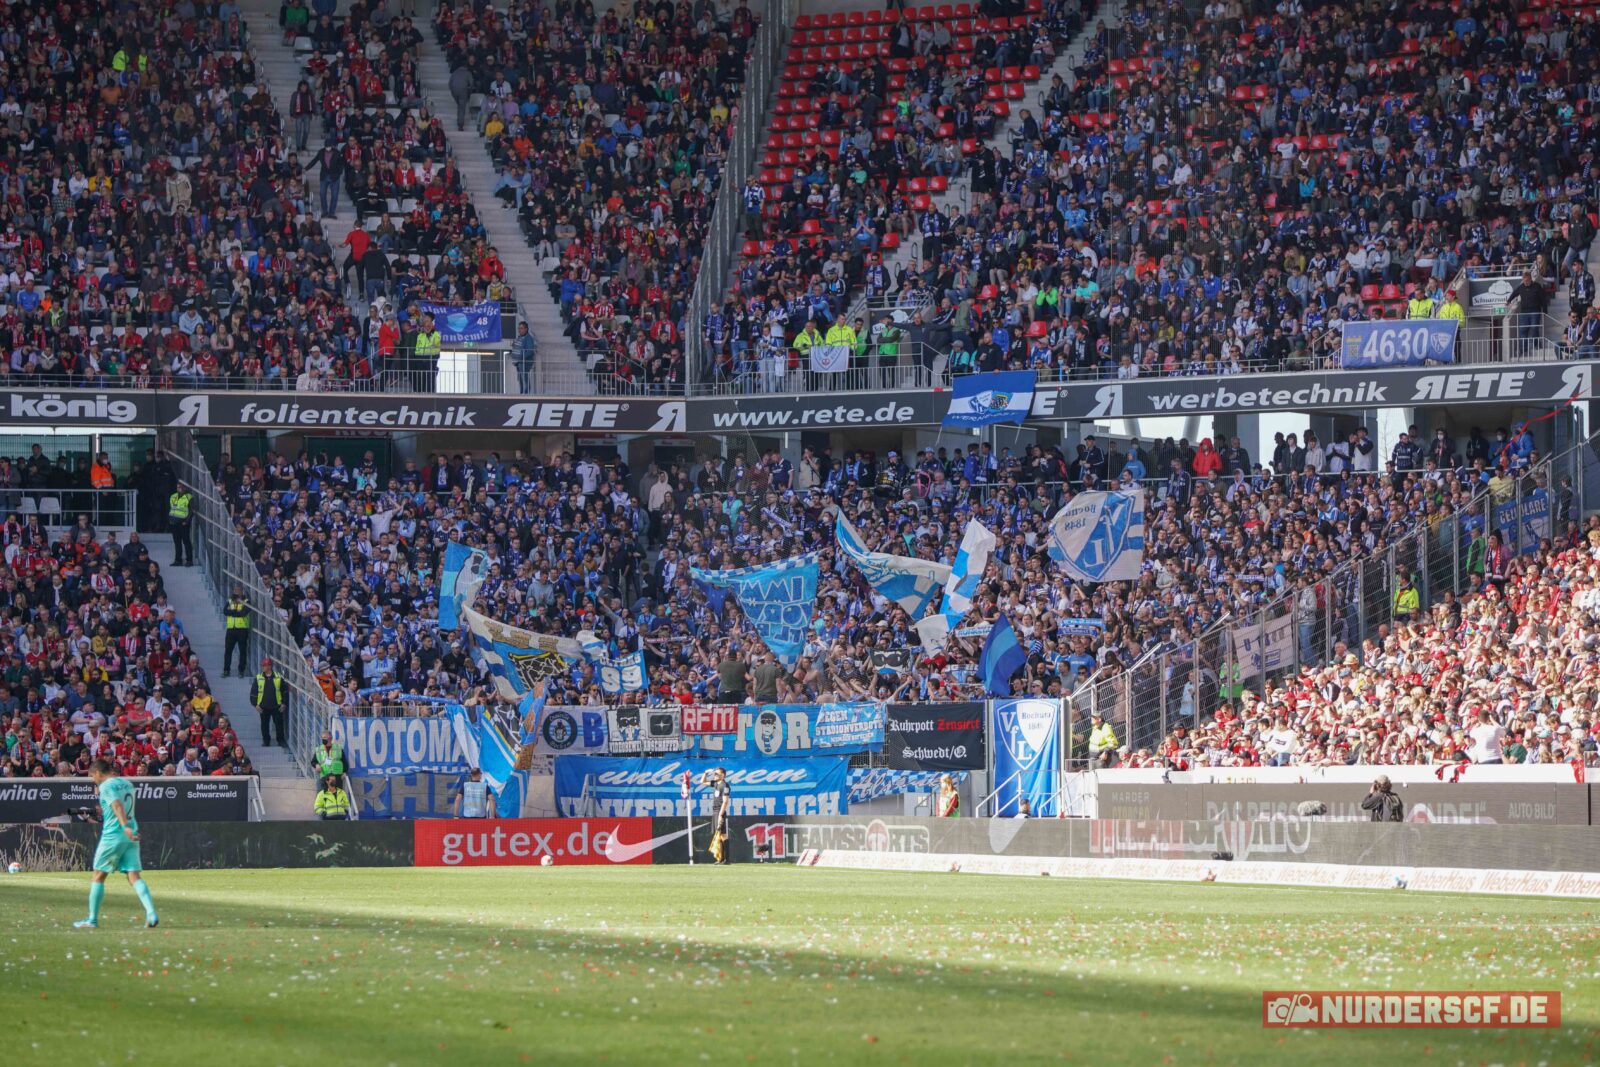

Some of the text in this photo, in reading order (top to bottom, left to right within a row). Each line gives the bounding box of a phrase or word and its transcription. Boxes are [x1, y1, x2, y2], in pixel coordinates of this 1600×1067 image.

[477, 317, 488, 325] 48
[440, 330, 489, 341] andemie
[1362, 327, 1429, 363] 4630
[1147, 381, 1388, 411] werbetechnik
[11, 394, 137, 423] könig
[240, 403, 476, 427] folientechnik
[713, 401, 915, 428] www.rete.de
[587, 466, 594, 478] 7
[683, 707, 734, 731] RFM
[889, 718, 934, 733] Ruhrpott
[902, 745, 967, 760] Schwedt/O.
[187, 791, 238, 799] Schwarzwald
[1508, 802, 1555, 819] AUTO BILD
[442, 822, 613, 865] gutex.de
